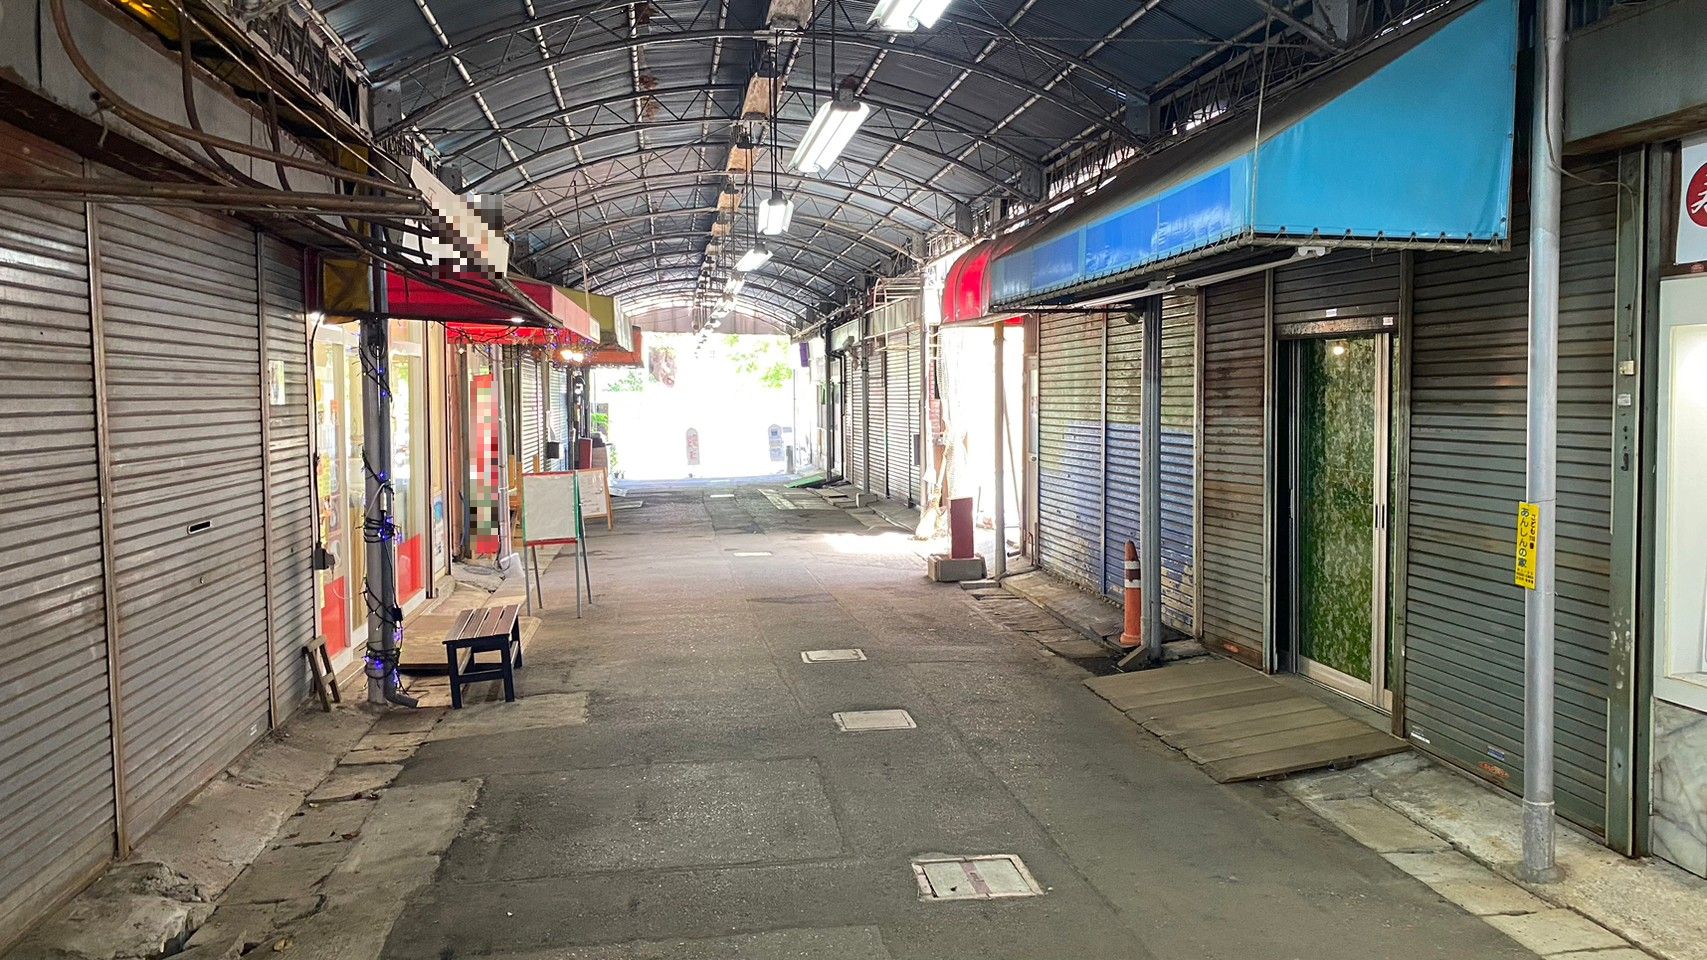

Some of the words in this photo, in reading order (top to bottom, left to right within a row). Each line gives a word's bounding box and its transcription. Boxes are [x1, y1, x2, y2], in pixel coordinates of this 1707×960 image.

[1518, 508, 1530, 568] あんしんの家
